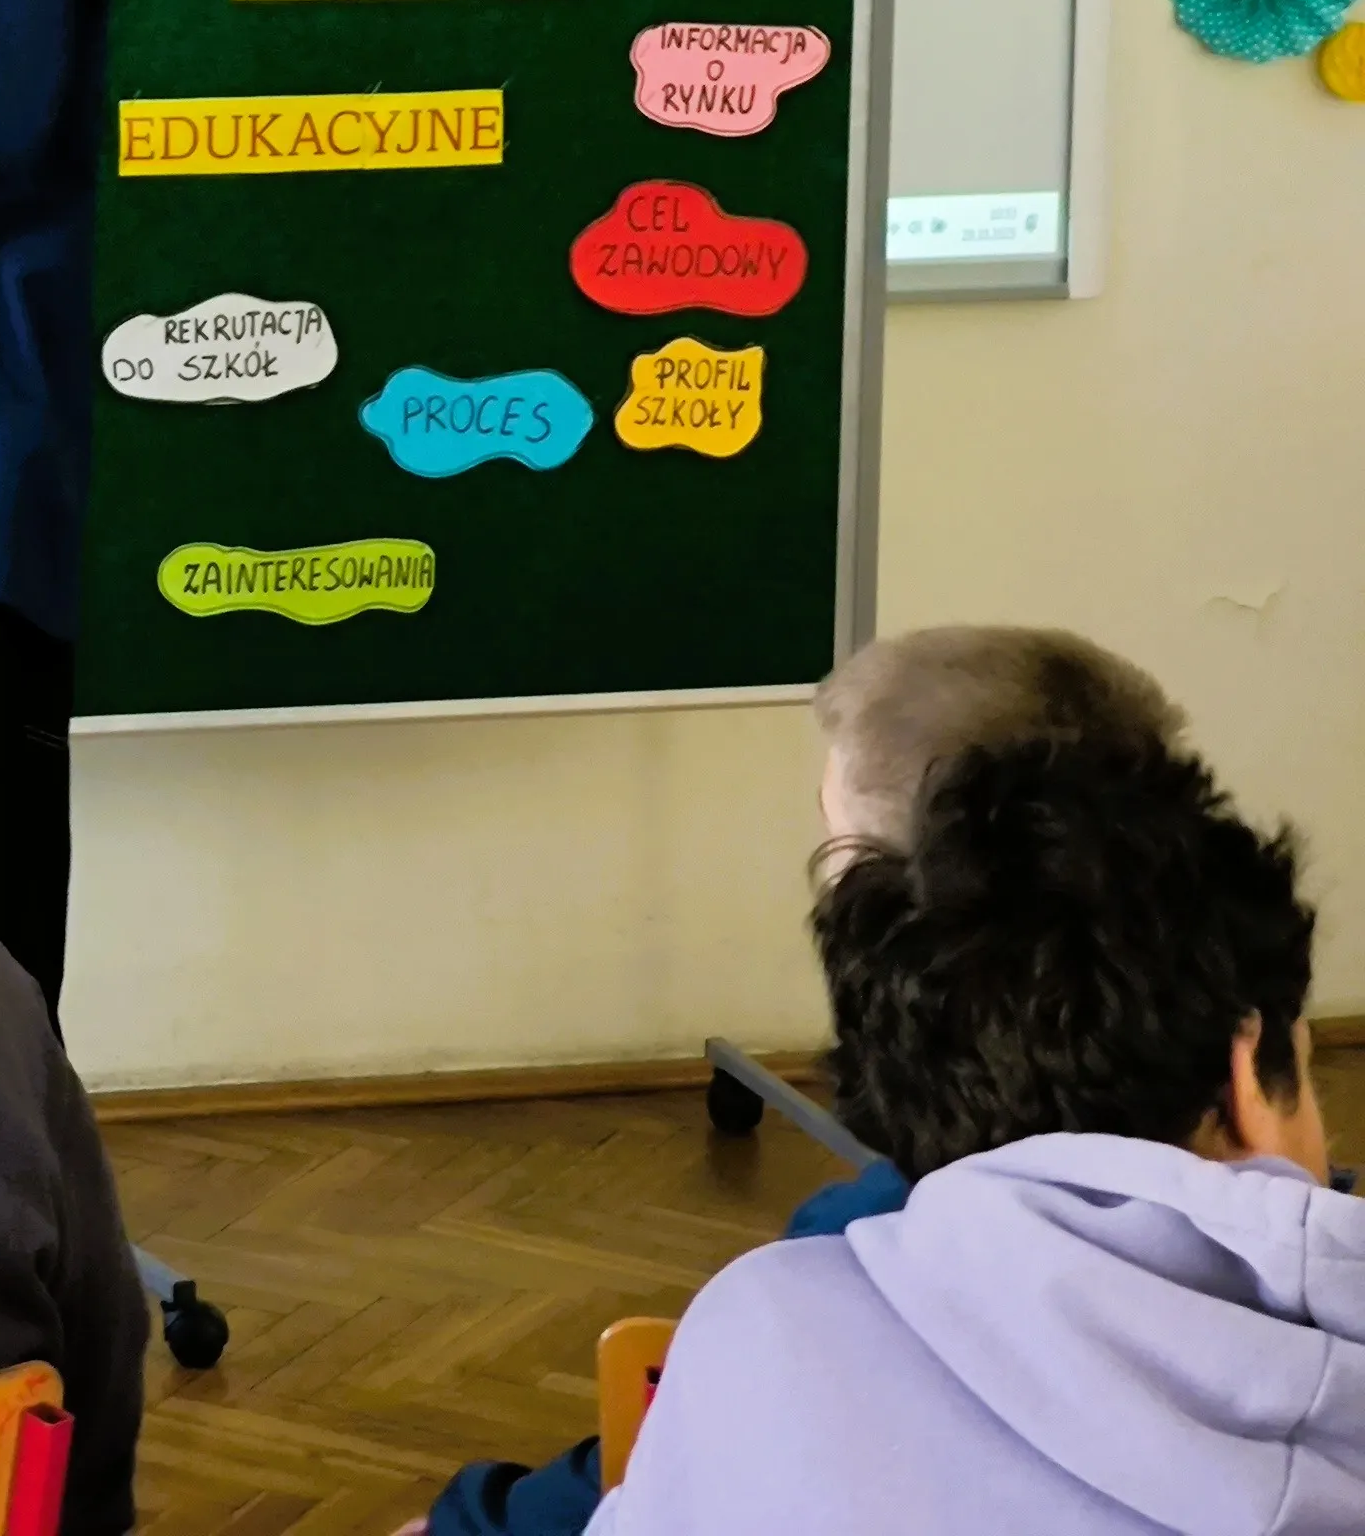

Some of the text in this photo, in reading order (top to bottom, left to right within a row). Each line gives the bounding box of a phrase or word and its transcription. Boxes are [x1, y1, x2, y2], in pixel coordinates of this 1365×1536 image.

[660, 27, 807, 63] INFORMACJA
[707, 59, 725, 83] O
[661, 83, 757, 116] RYNKU
[123, 107, 502, 163] EDUKACYJNE
[625, 194, 690, 233] CEL
[596, 243, 789, 282] ZAWODOWY
[164, 303, 323, 345] REKRUTACJA
[112, 341, 280, 383] DO SZKÓŁ
[654, 355, 752, 391] PROFIL
[401, 395, 553, 444] PROCES
[633, 398, 744, 430] SZKOŁY
[182, 552, 434, 596] ZAINTERESOWANIA
